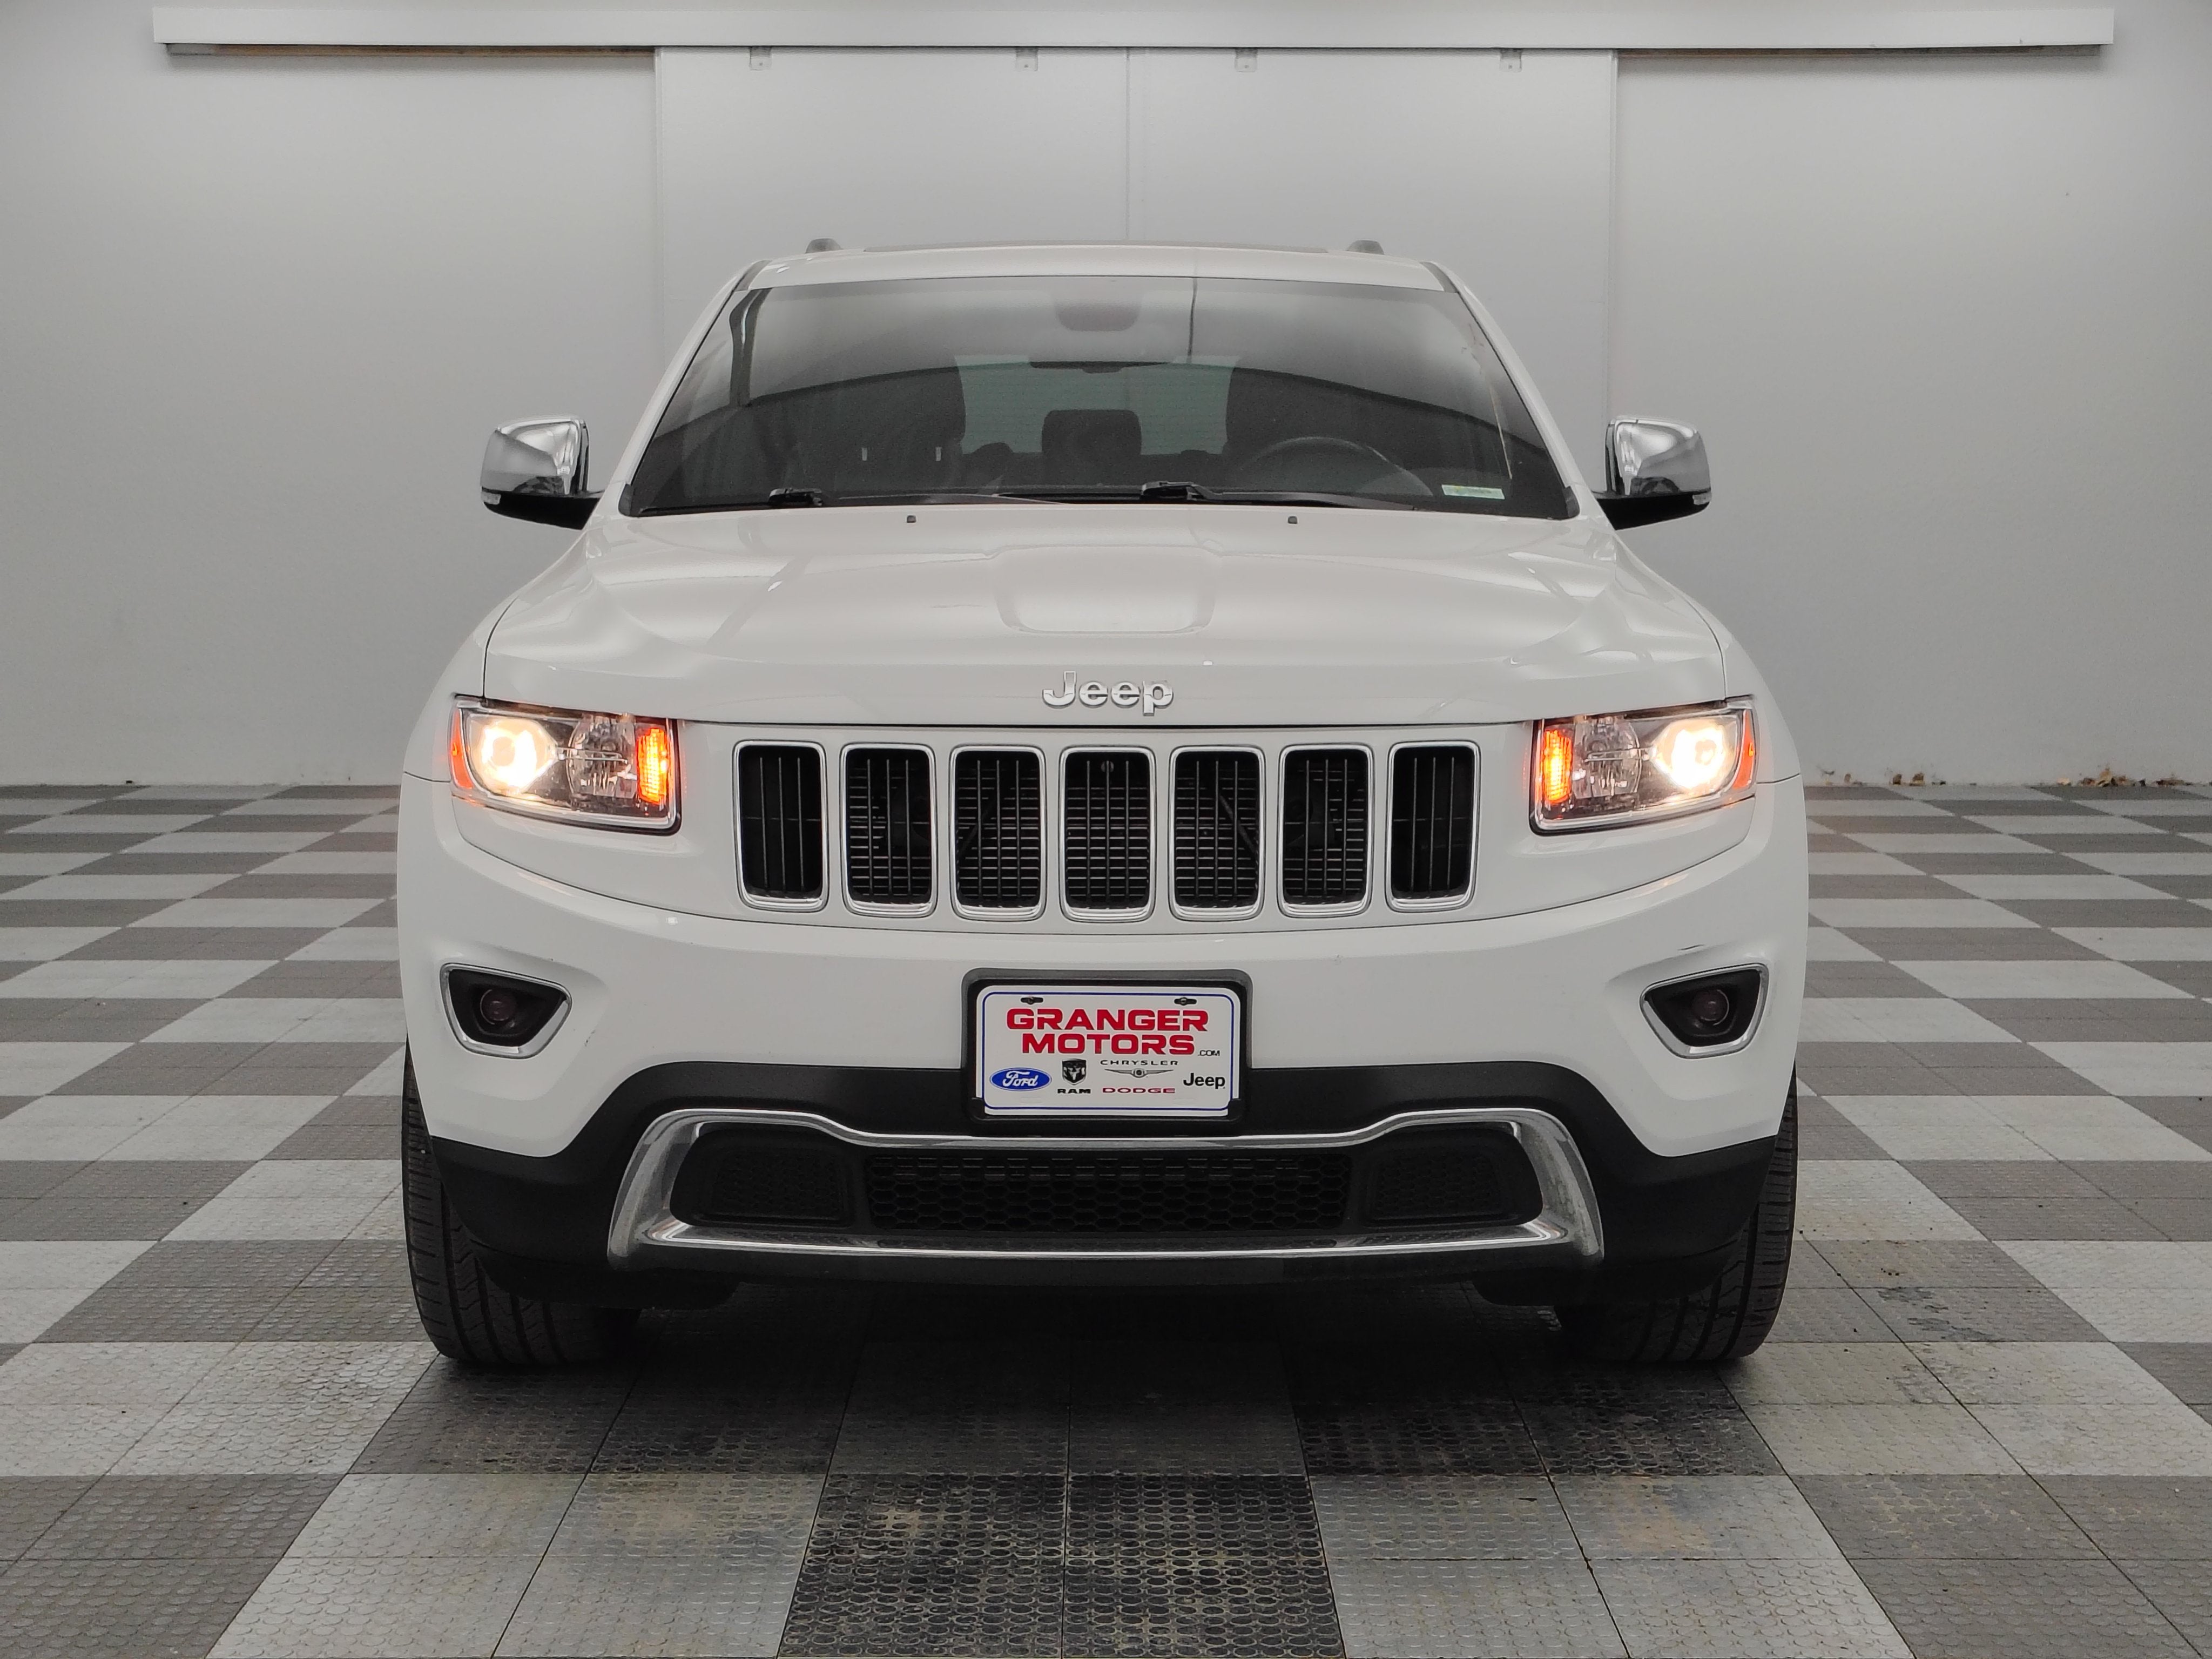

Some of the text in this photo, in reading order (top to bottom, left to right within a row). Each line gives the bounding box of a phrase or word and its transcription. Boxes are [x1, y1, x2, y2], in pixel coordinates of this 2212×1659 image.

[1042, 671, 1174, 716] Jeep
[1007, 1009, 1208, 1031] GRANGER
[1022, 1034, 1195, 1055] MOTORS
[1002, 1070, 1039, 1088] Ford
[1183, 1073, 1225, 1089] Jeep
